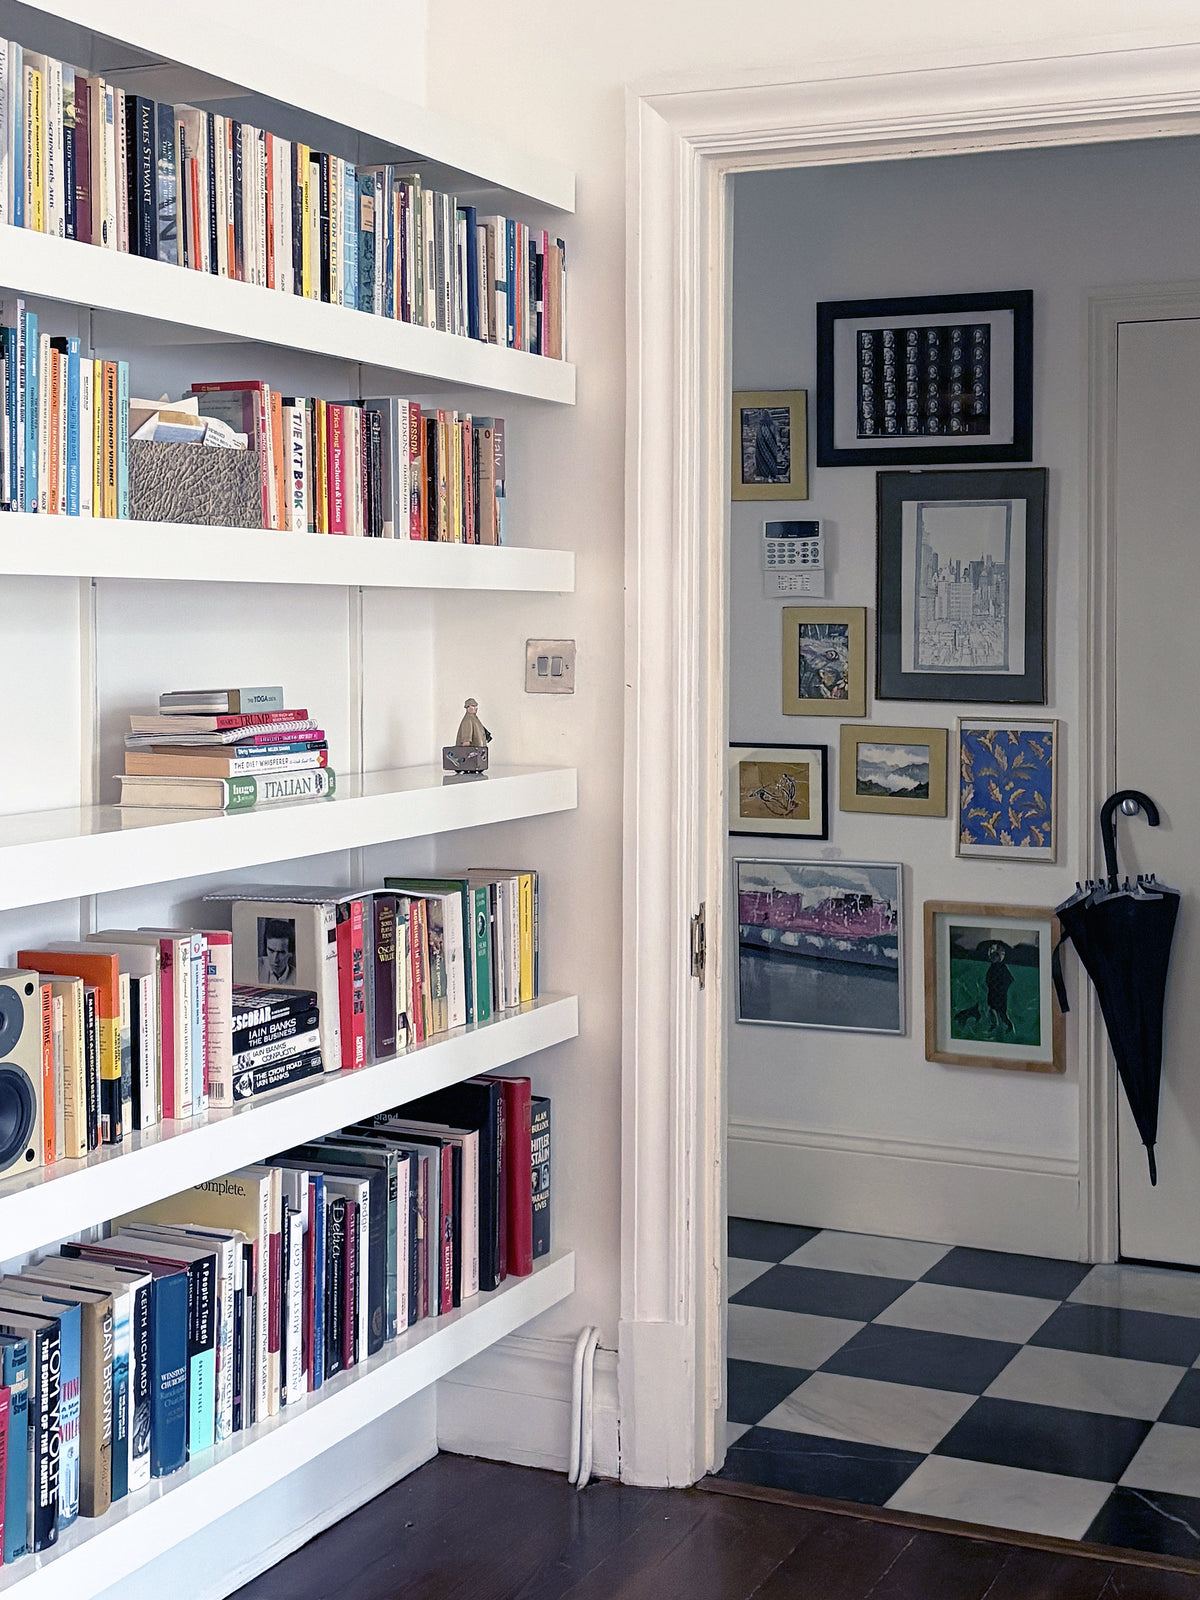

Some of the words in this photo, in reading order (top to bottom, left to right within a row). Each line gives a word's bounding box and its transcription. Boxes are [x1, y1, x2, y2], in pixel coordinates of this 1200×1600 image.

[142, 105, 151, 143] JAMES
[293, 412, 302, 439] THE
[109, 439, 114, 449] OF
[494, 433, 503, 466] Italy
[293, 442, 303, 468] ART
[294, 470, 304, 510] BOOK
[240, 714, 270, 726] TRUMP
[260, 758, 288, 766] WHISPERER
[233, 784, 254, 794] hugo
[265, 777, 311, 798] ITALIAN
[232, 1006, 271, 1030] ESCOBAR
[89, 1030, 94, 1041] AN
[248, 1037, 262, 1047] THE
[263, 1027, 296, 1043] BUSINESS
[249, 1027, 267, 1038] IAIN
[270, 1018, 296, 1033] BANKS
[253, 1048, 264, 1057] IAIN
[265, 1042, 287, 1054] BANKS
[262, 1046, 296, 1062] COMPLICITY
[255, 1071, 267, 1080] THE
[268, 1066, 285, 1075] CROW
[286, 1061, 302, 1070] ROAD
[256, 1078, 268, 1088] IAIN
[269, 1071, 290, 1084] BANKS
[534, 1111, 547, 1123] ALAN
[531, 1122, 549, 1133] BULLOCK
[531, 1133, 550, 1152] HITLER
[531, 1149, 550, 1166] STALIN
[194, 1180, 246, 1197] omplete.
[535, 1202, 547, 1212] LIVES
[333, 1204, 345, 1259] Delia
[200, 1309, 208, 1344] Tragedy
[103, 1319, 112, 1361] DAN
[50, 1331, 60, 1398] TOM
[103, 1365, 112, 1439] BROWN
[41, 1414, 48, 1429] OF
[50, 1399, 60, 1504] WOLFE
